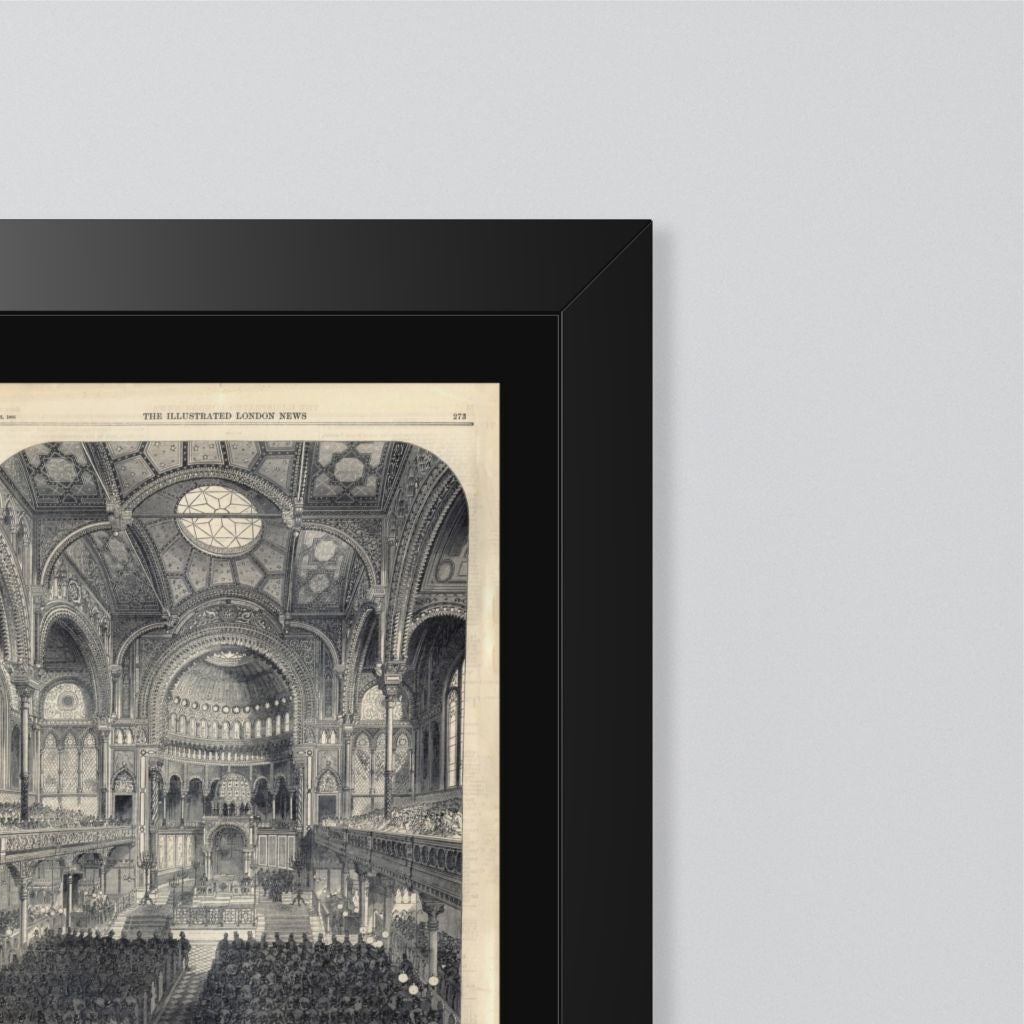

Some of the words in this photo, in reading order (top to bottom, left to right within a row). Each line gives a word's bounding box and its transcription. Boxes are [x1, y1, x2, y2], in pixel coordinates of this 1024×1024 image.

[142, 412, 163, 421] THE
[166, 411, 233, 420] ILLUSTRATED
[235, 411, 276, 420] LONDON
[279, 411, 308, 420] NEWS
